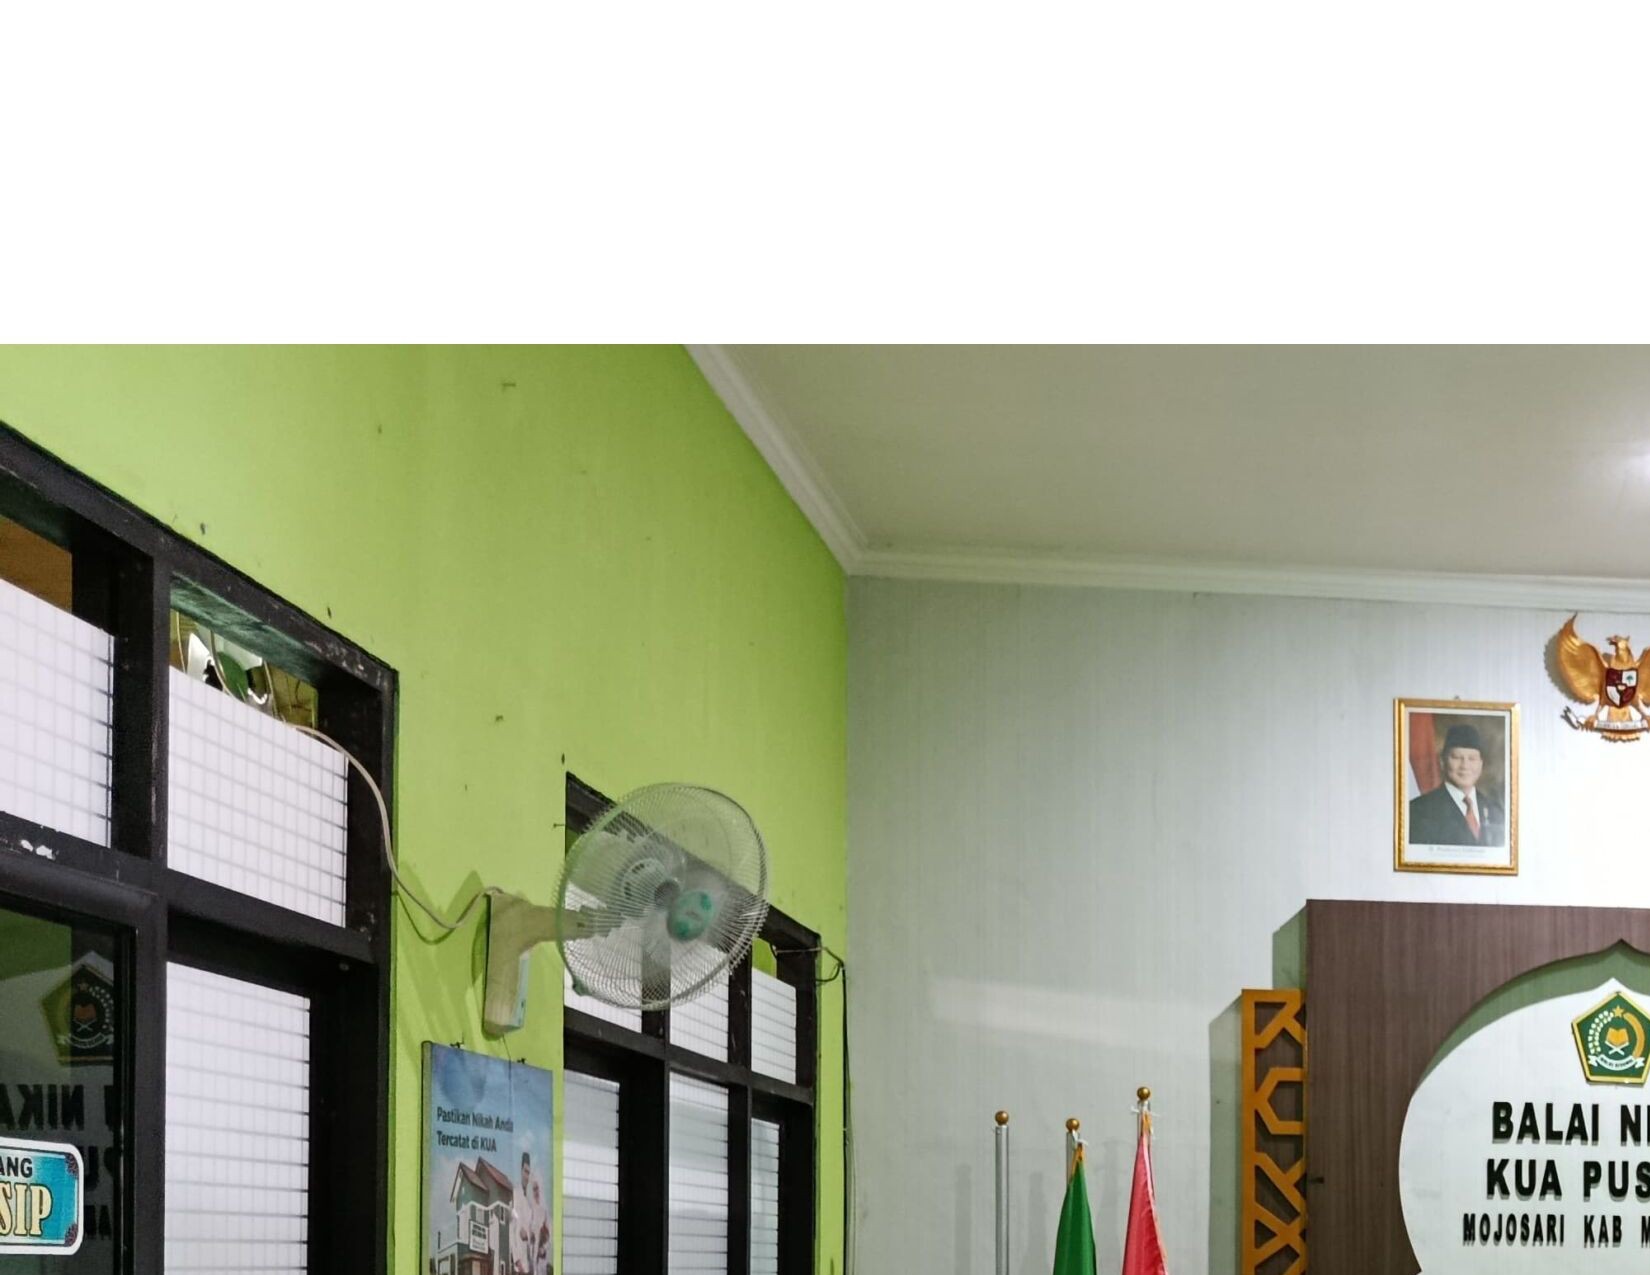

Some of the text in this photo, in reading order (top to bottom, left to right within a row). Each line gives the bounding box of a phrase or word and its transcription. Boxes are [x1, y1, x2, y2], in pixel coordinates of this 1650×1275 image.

[437, 1106, 513, 1132] Pastikan Nikah Anda
[1492, 1101, 1599, 1144] BALAI
[437, 1130, 497, 1152] Tercatat di KUA
[1487, 1158, 1562, 1199] KUA
[1463, 1213, 1565, 1246] MOJOSARI
[1584, 1215, 1622, 1248] KAB
